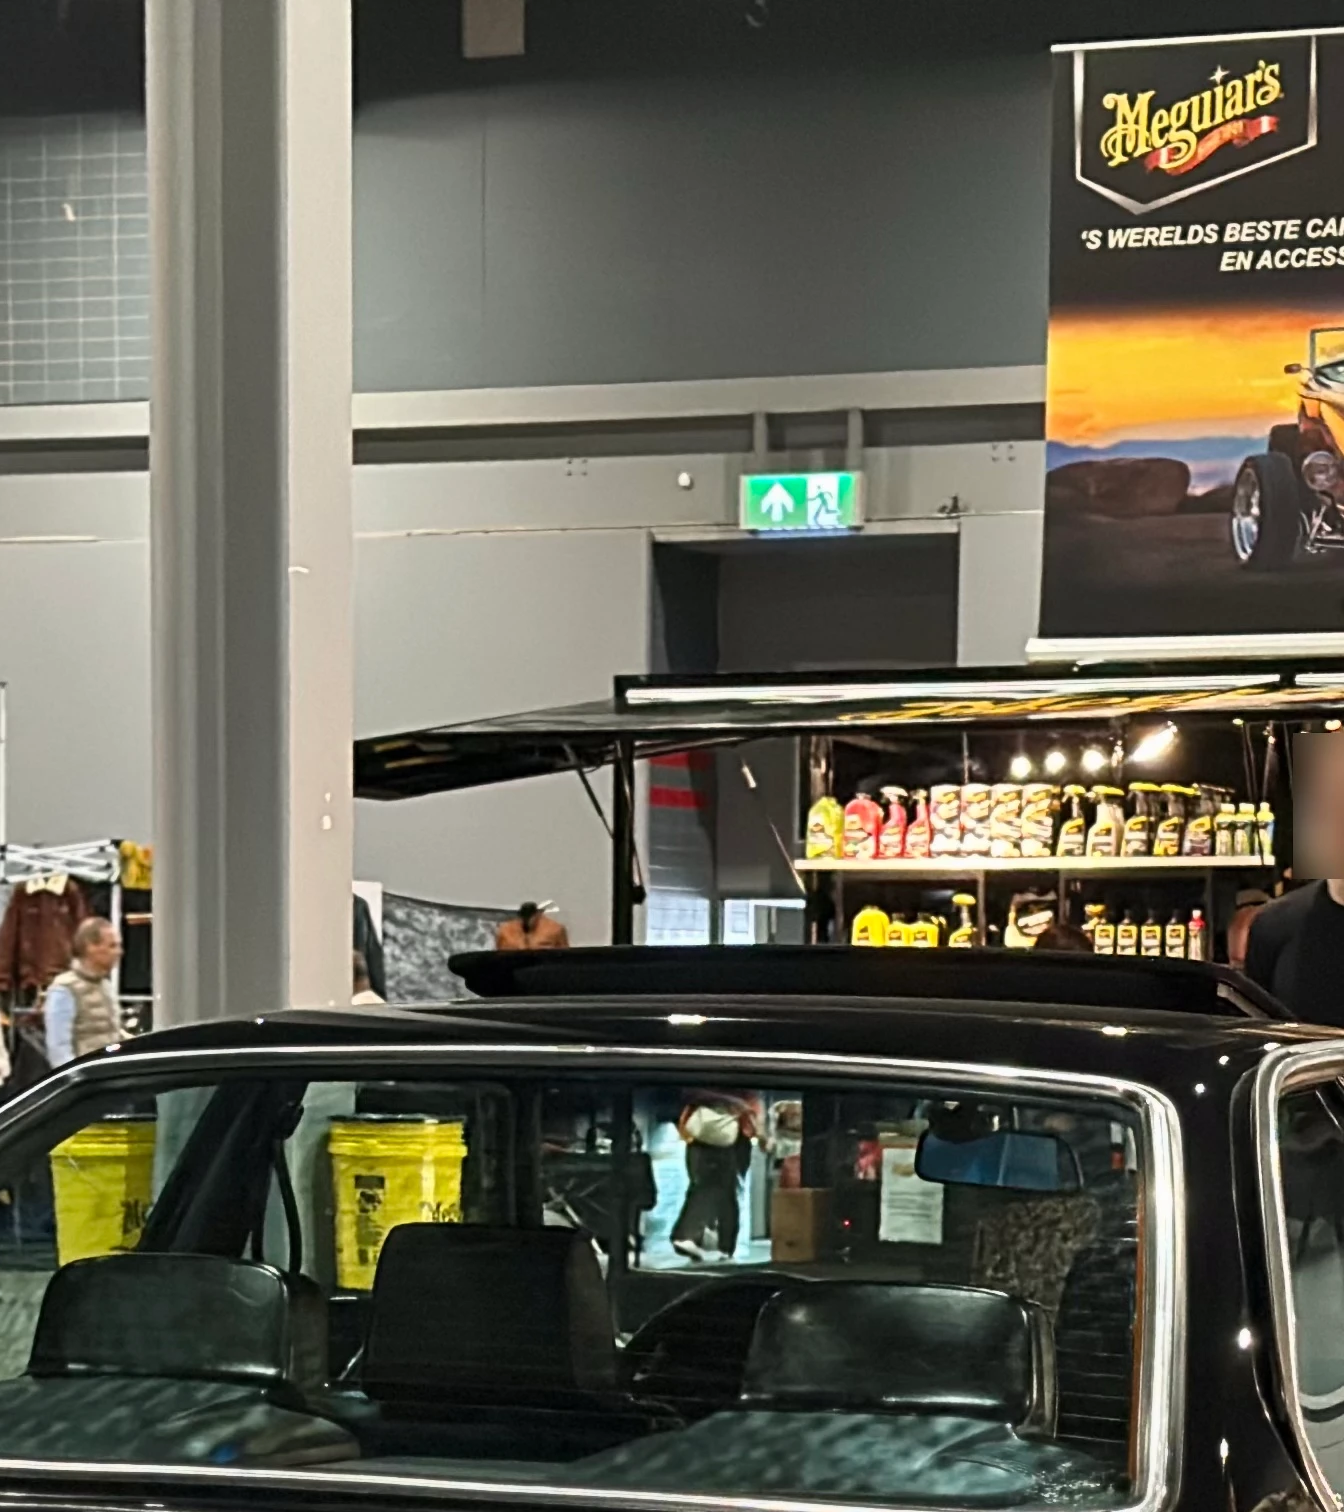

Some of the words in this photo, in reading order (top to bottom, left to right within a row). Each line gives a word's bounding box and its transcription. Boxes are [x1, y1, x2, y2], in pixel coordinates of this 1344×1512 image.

[1100, 59, 1281, 170] Meguiar's
[1107, 223, 1219, 248] WERELDS
[1223, 219, 1301, 244] BESTE
[1220, 250, 1254, 272] EN
